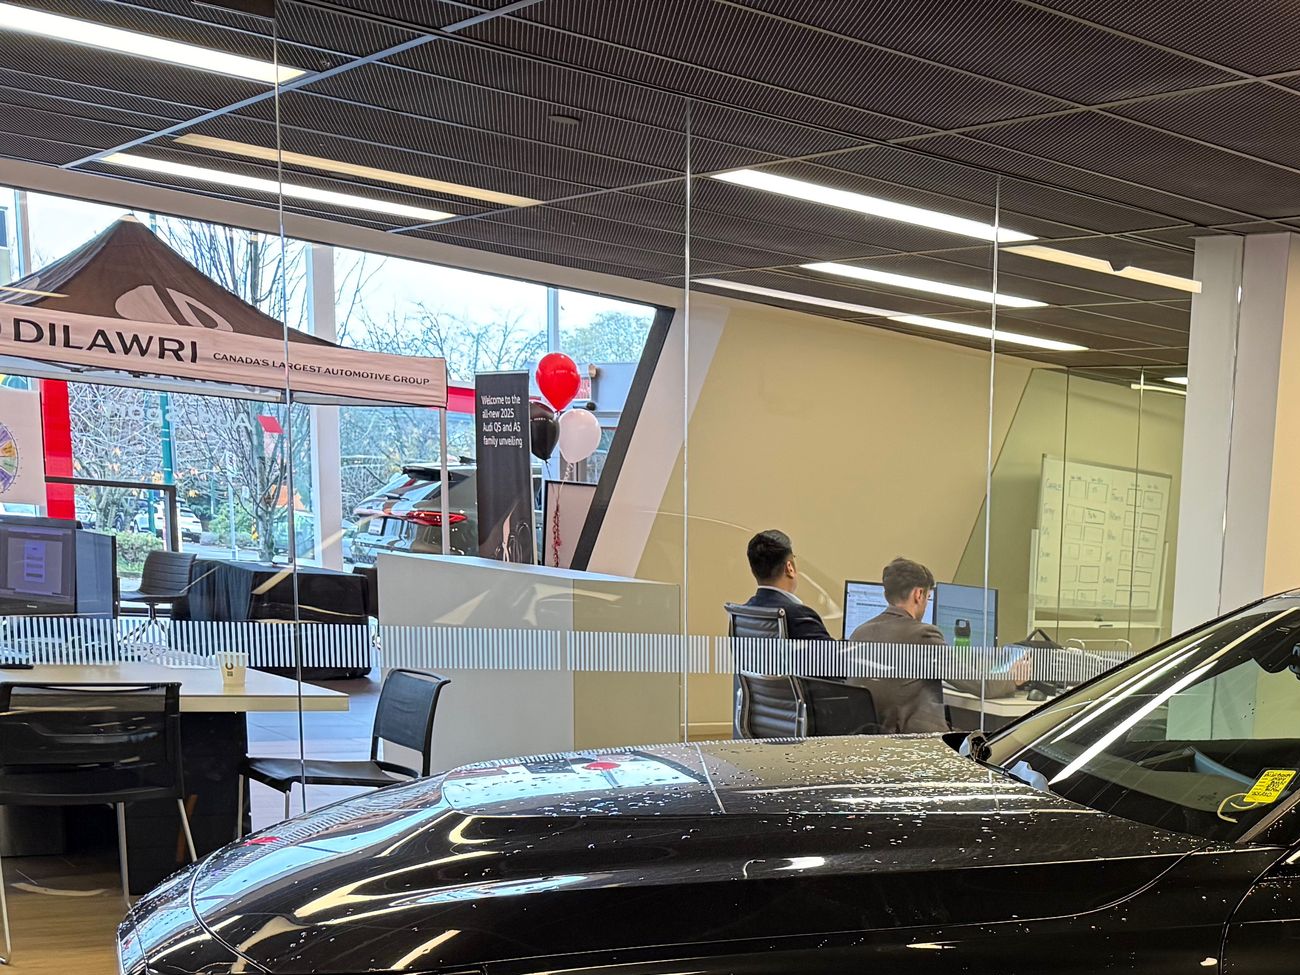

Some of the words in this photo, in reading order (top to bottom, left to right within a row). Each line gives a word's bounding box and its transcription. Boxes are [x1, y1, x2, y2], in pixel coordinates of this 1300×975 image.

[13, 317, 198, 364] DILAWRI
[213, 352, 270, 367] CANADA'S
[272, 360, 322, 374] LARGEST
[324, 367, 391, 382] AUTOMOTIVE
[393, 374, 430, 386] GROUP
[481, 395, 504, 405] Welcome
[511, 394, 520, 404] the
[482, 409, 500, 419] all-new
[500, 408, 515, 418] 2025
[482, 422, 493, 432] Audi
[502, 422, 512, 432] and
[483, 436, 498, 447] family
[499, 436, 522, 448] unveiling
